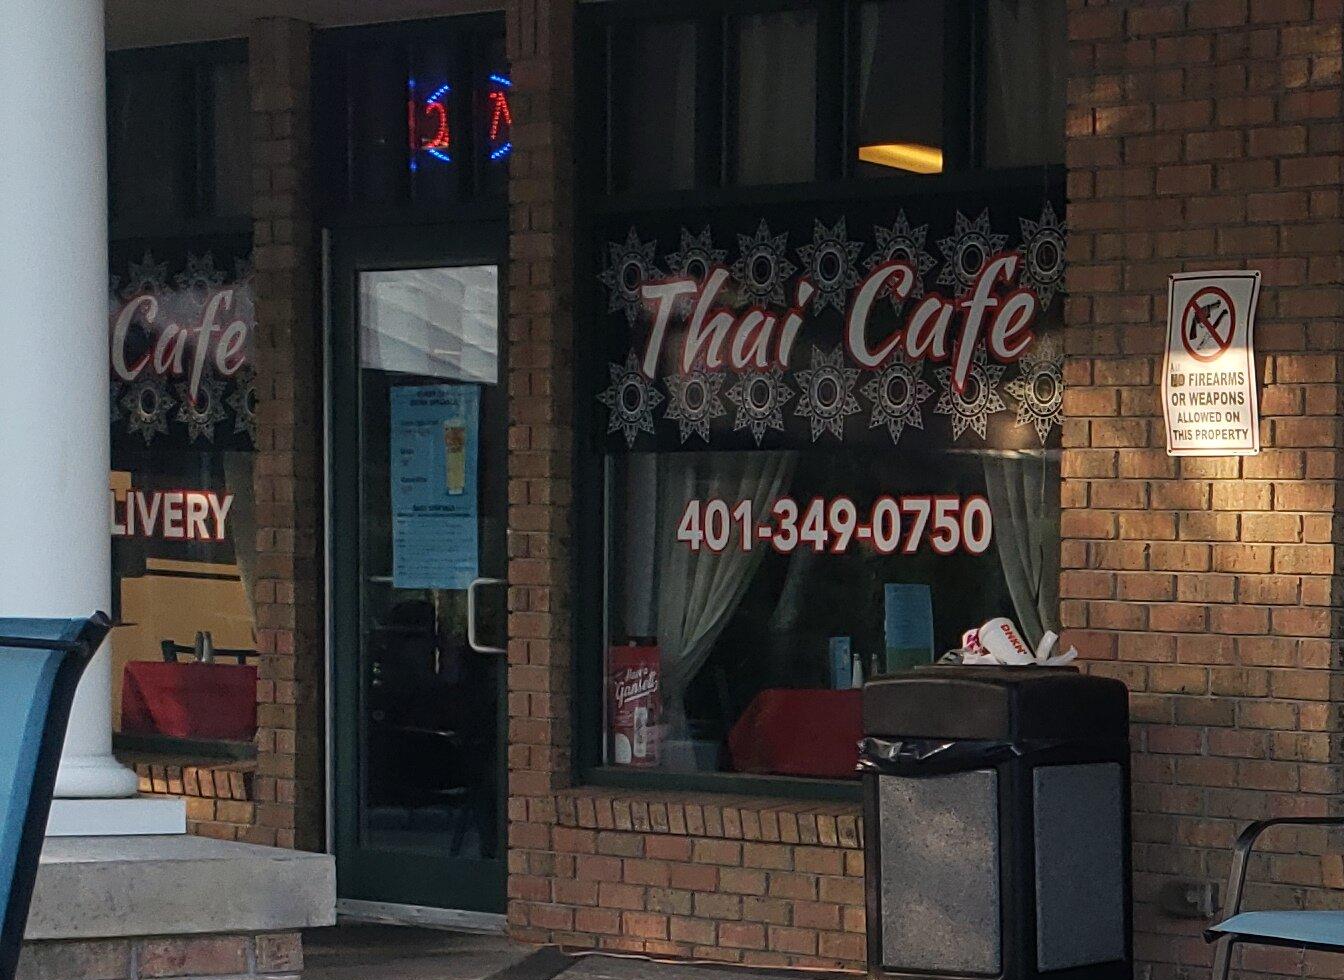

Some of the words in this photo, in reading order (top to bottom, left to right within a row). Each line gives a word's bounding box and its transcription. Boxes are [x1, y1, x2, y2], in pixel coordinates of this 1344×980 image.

[641, 266, 816, 381] Thai
[846, 253, 1038, 394] Cafe
[110, 289, 248, 407] Cafe
[1188, 371, 1245, 386] FIREARMS
[1171, 392, 1186, 406] OR
[1188, 391, 1245, 405] WEAPONS
[1177, 411, 1222, 423] ALLOWED
[1225, 411, 1241, 422] ON
[1172, 429, 1193, 440] THIS
[1195, 428, 1249, 440] PROPERTY
[111, 490, 234, 540] LIVERY
[676, 497, 993, 554] 401-349-0750
